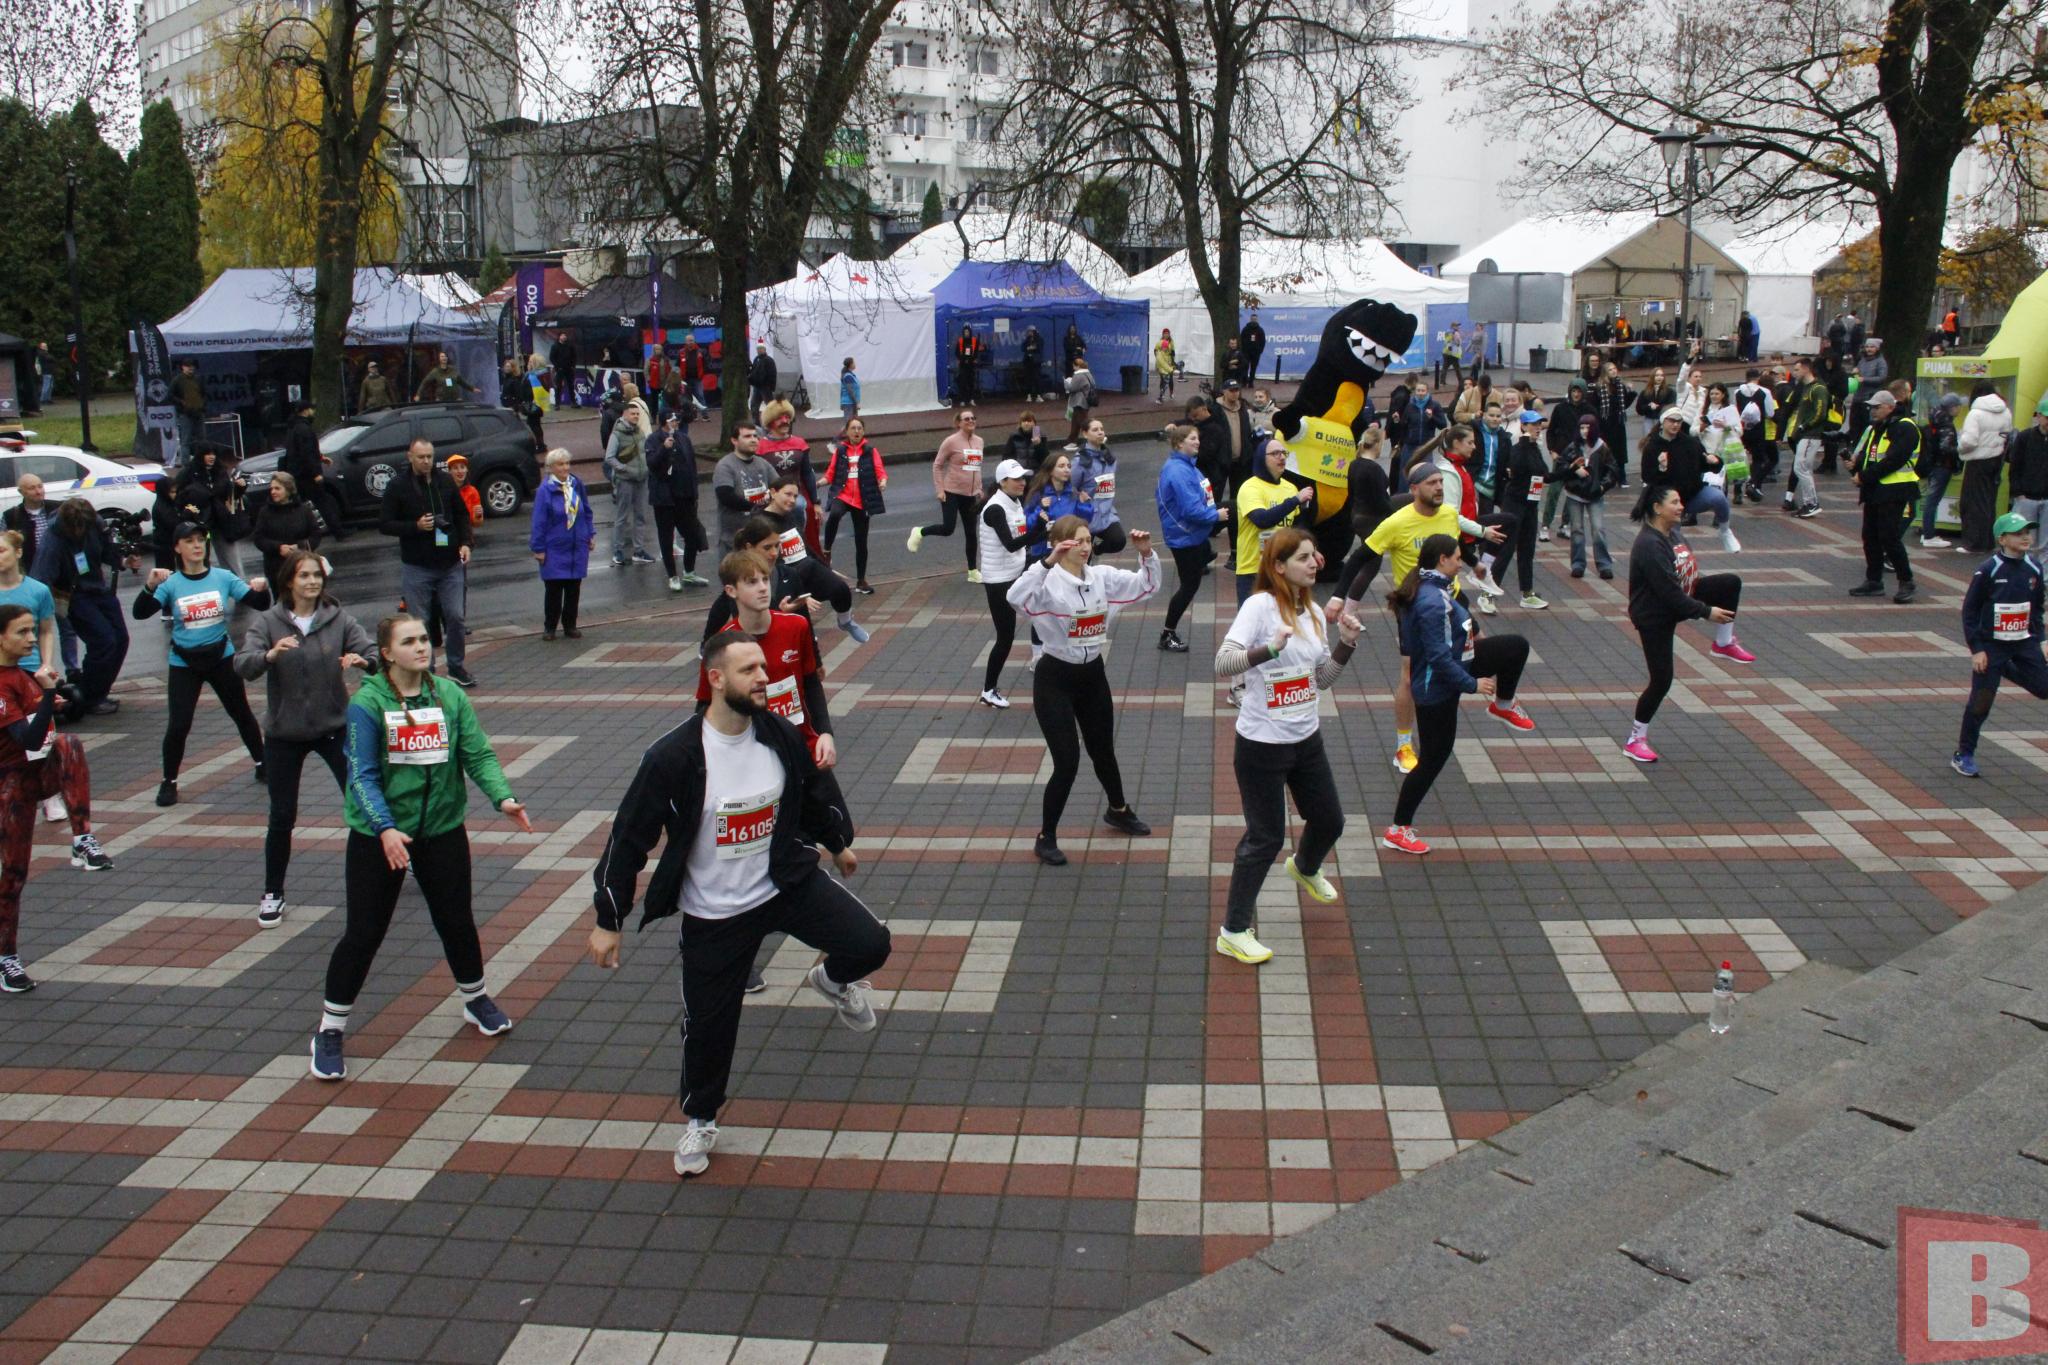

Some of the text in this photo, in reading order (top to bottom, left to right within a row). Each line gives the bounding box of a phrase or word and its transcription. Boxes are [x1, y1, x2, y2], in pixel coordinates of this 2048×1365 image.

[981, 287, 1015, 299] RUN
[205, 336, 279, 345] СПЕЦІАЛЬНИХ
[1274, 346, 1305, 355] ЗОНА
[1923, 361, 1953, 374] PUMA
[190, 607, 219, 620] 16005
[1276, 687, 1310, 705] 16008
[399, 735, 441, 750] 16006
[729, 817, 773, 842] 16105
